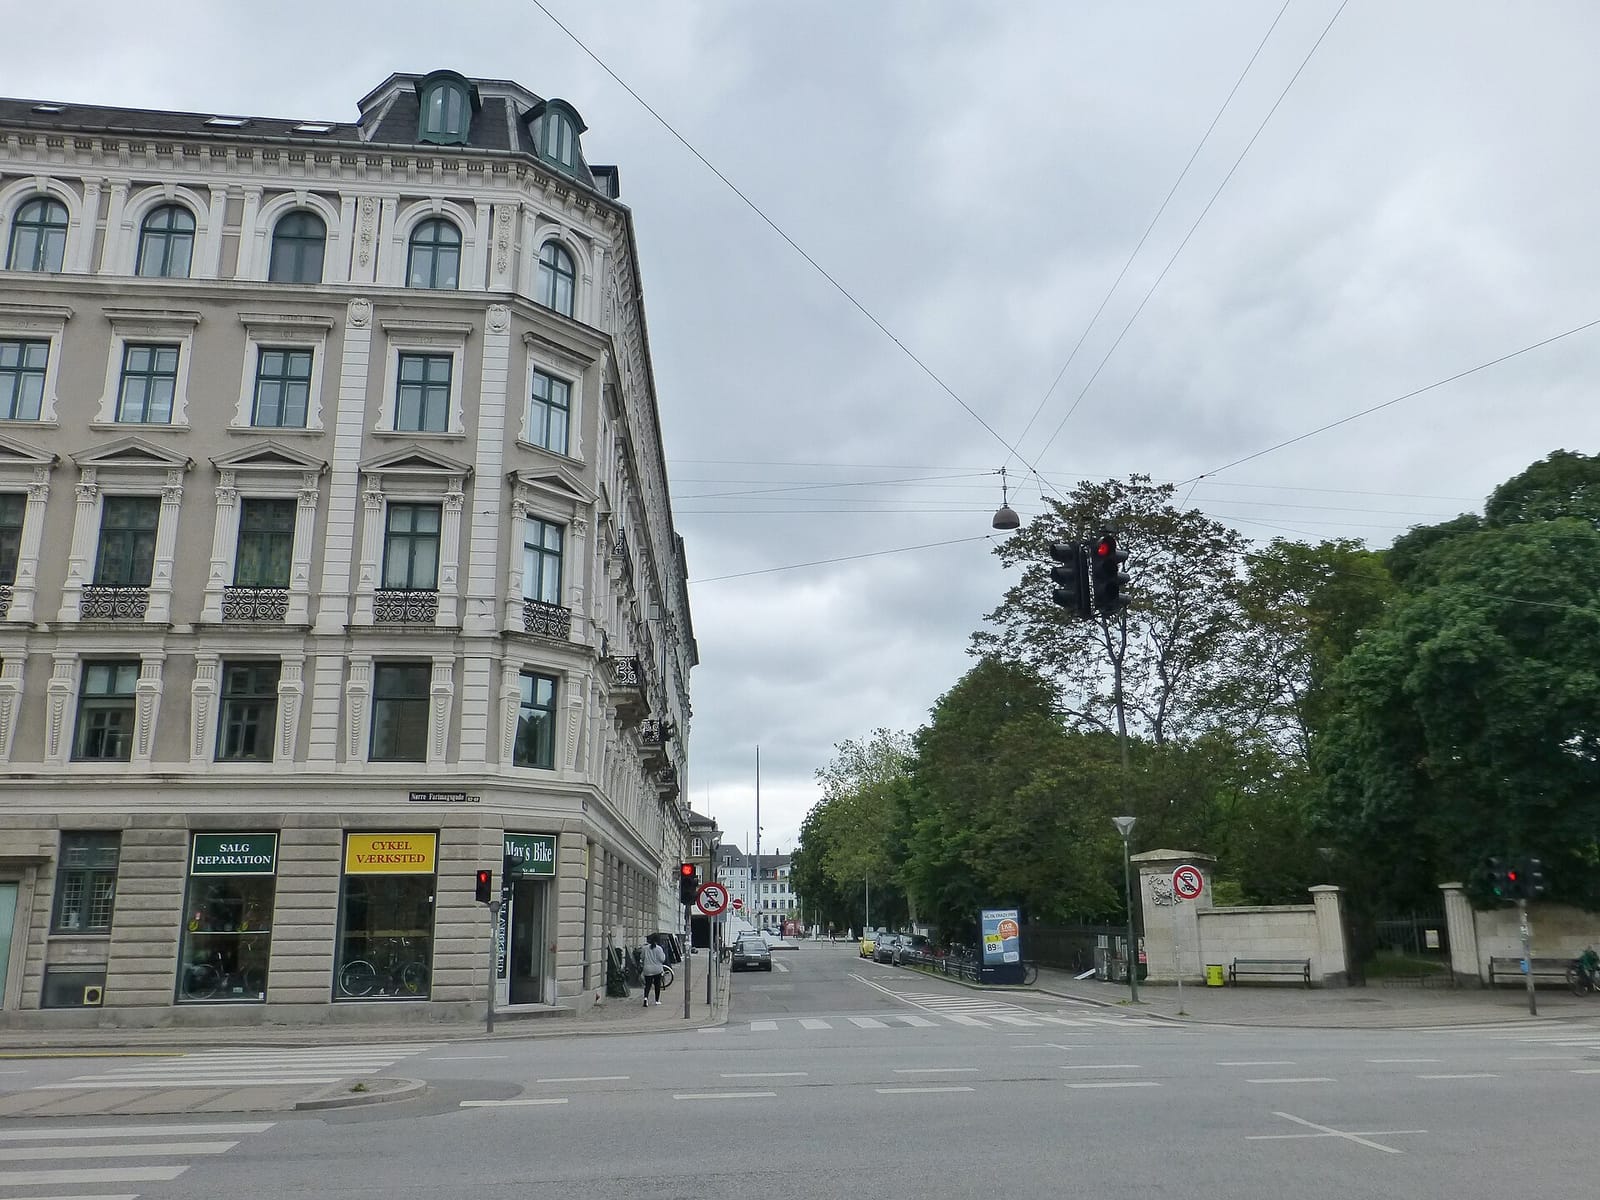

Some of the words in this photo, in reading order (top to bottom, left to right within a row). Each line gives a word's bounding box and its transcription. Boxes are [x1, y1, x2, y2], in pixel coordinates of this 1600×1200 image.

[219, 843, 250, 853] SALG
[371, 841, 412, 850] CYKEL
[533, 842, 552, 861] Bike
[196, 855, 271, 865] REPARATION
[356, 854, 426, 863] VÆRKSTED
[987, 944, 997, 952] 89
